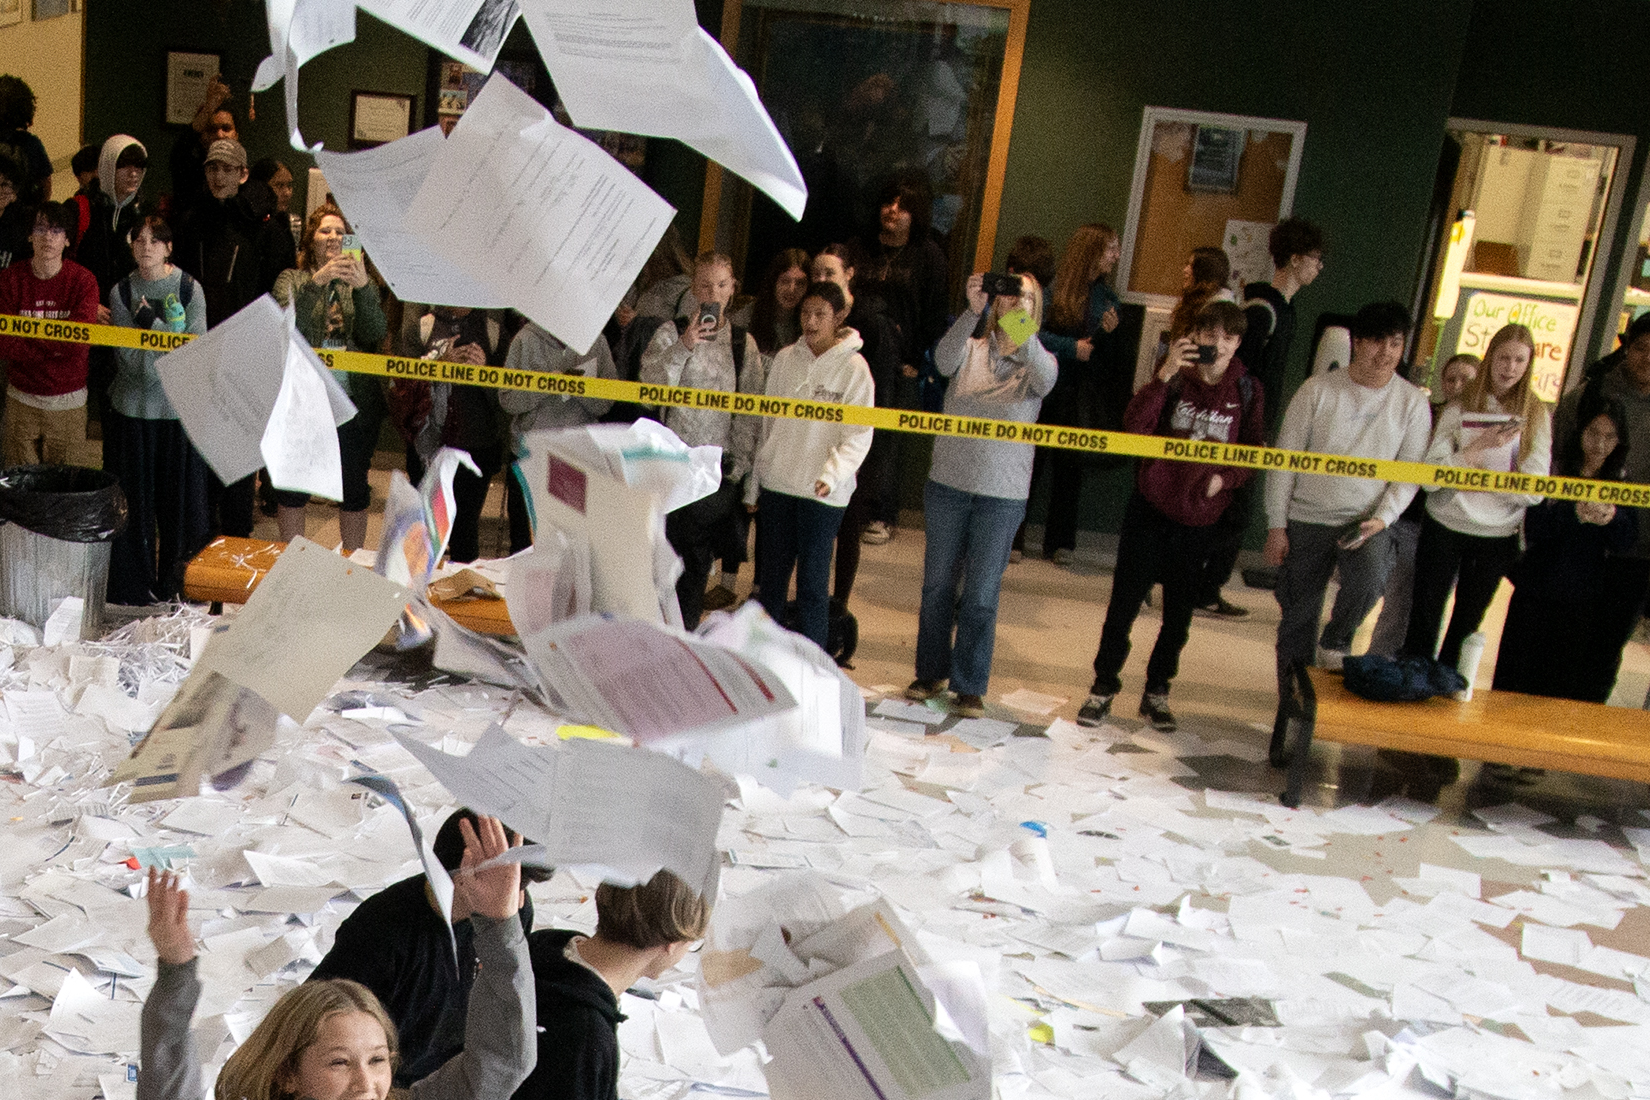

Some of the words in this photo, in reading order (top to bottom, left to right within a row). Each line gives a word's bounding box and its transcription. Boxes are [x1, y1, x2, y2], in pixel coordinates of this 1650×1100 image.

[12, 319, 40, 334] NOT
[44, 323, 90, 341] CROSS
[1473, 299, 1504, 318] Our
[1508, 301, 1557, 332] Office
[386, 358, 437, 377] POLICE
[442, 365, 474, 381] LINE
[479, 368, 499, 384] DO
[503, 371, 534, 388] NOT
[537, 376, 586, 394] CROSS
[639, 386, 692, 404] POLICE
[696, 392, 729, 409] LINE
[734, 396, 755, 412] DO
[759, 399, 791, 416] NOT
[794, 405, 844, 422] CROSS
[899, 413, 952, 432] POLICE
[957, 419, 990, 436] LINE
[996, 424, 1017, 439] DO
[1021, 426, 1054, 444] NOT
[1057, 431, 1108, 450] CROSS
[1163, 441, 1218, 460] POLICE
[1223, 447, 1257, 464] LINE
[1263, 452, 1284, 467] DO
[1289, 455, 1322, 472] NOT
[1325, 459, 1378, 478] CROSS
[1434, 468, 1490, 487] POLICE
[1494, 474, 1530, 491] LINE
[1535, 478, 1556, 494] DO
[1561, 481, 1595, 498] NOT
[1598, 486, 1650, 505] CROSS
